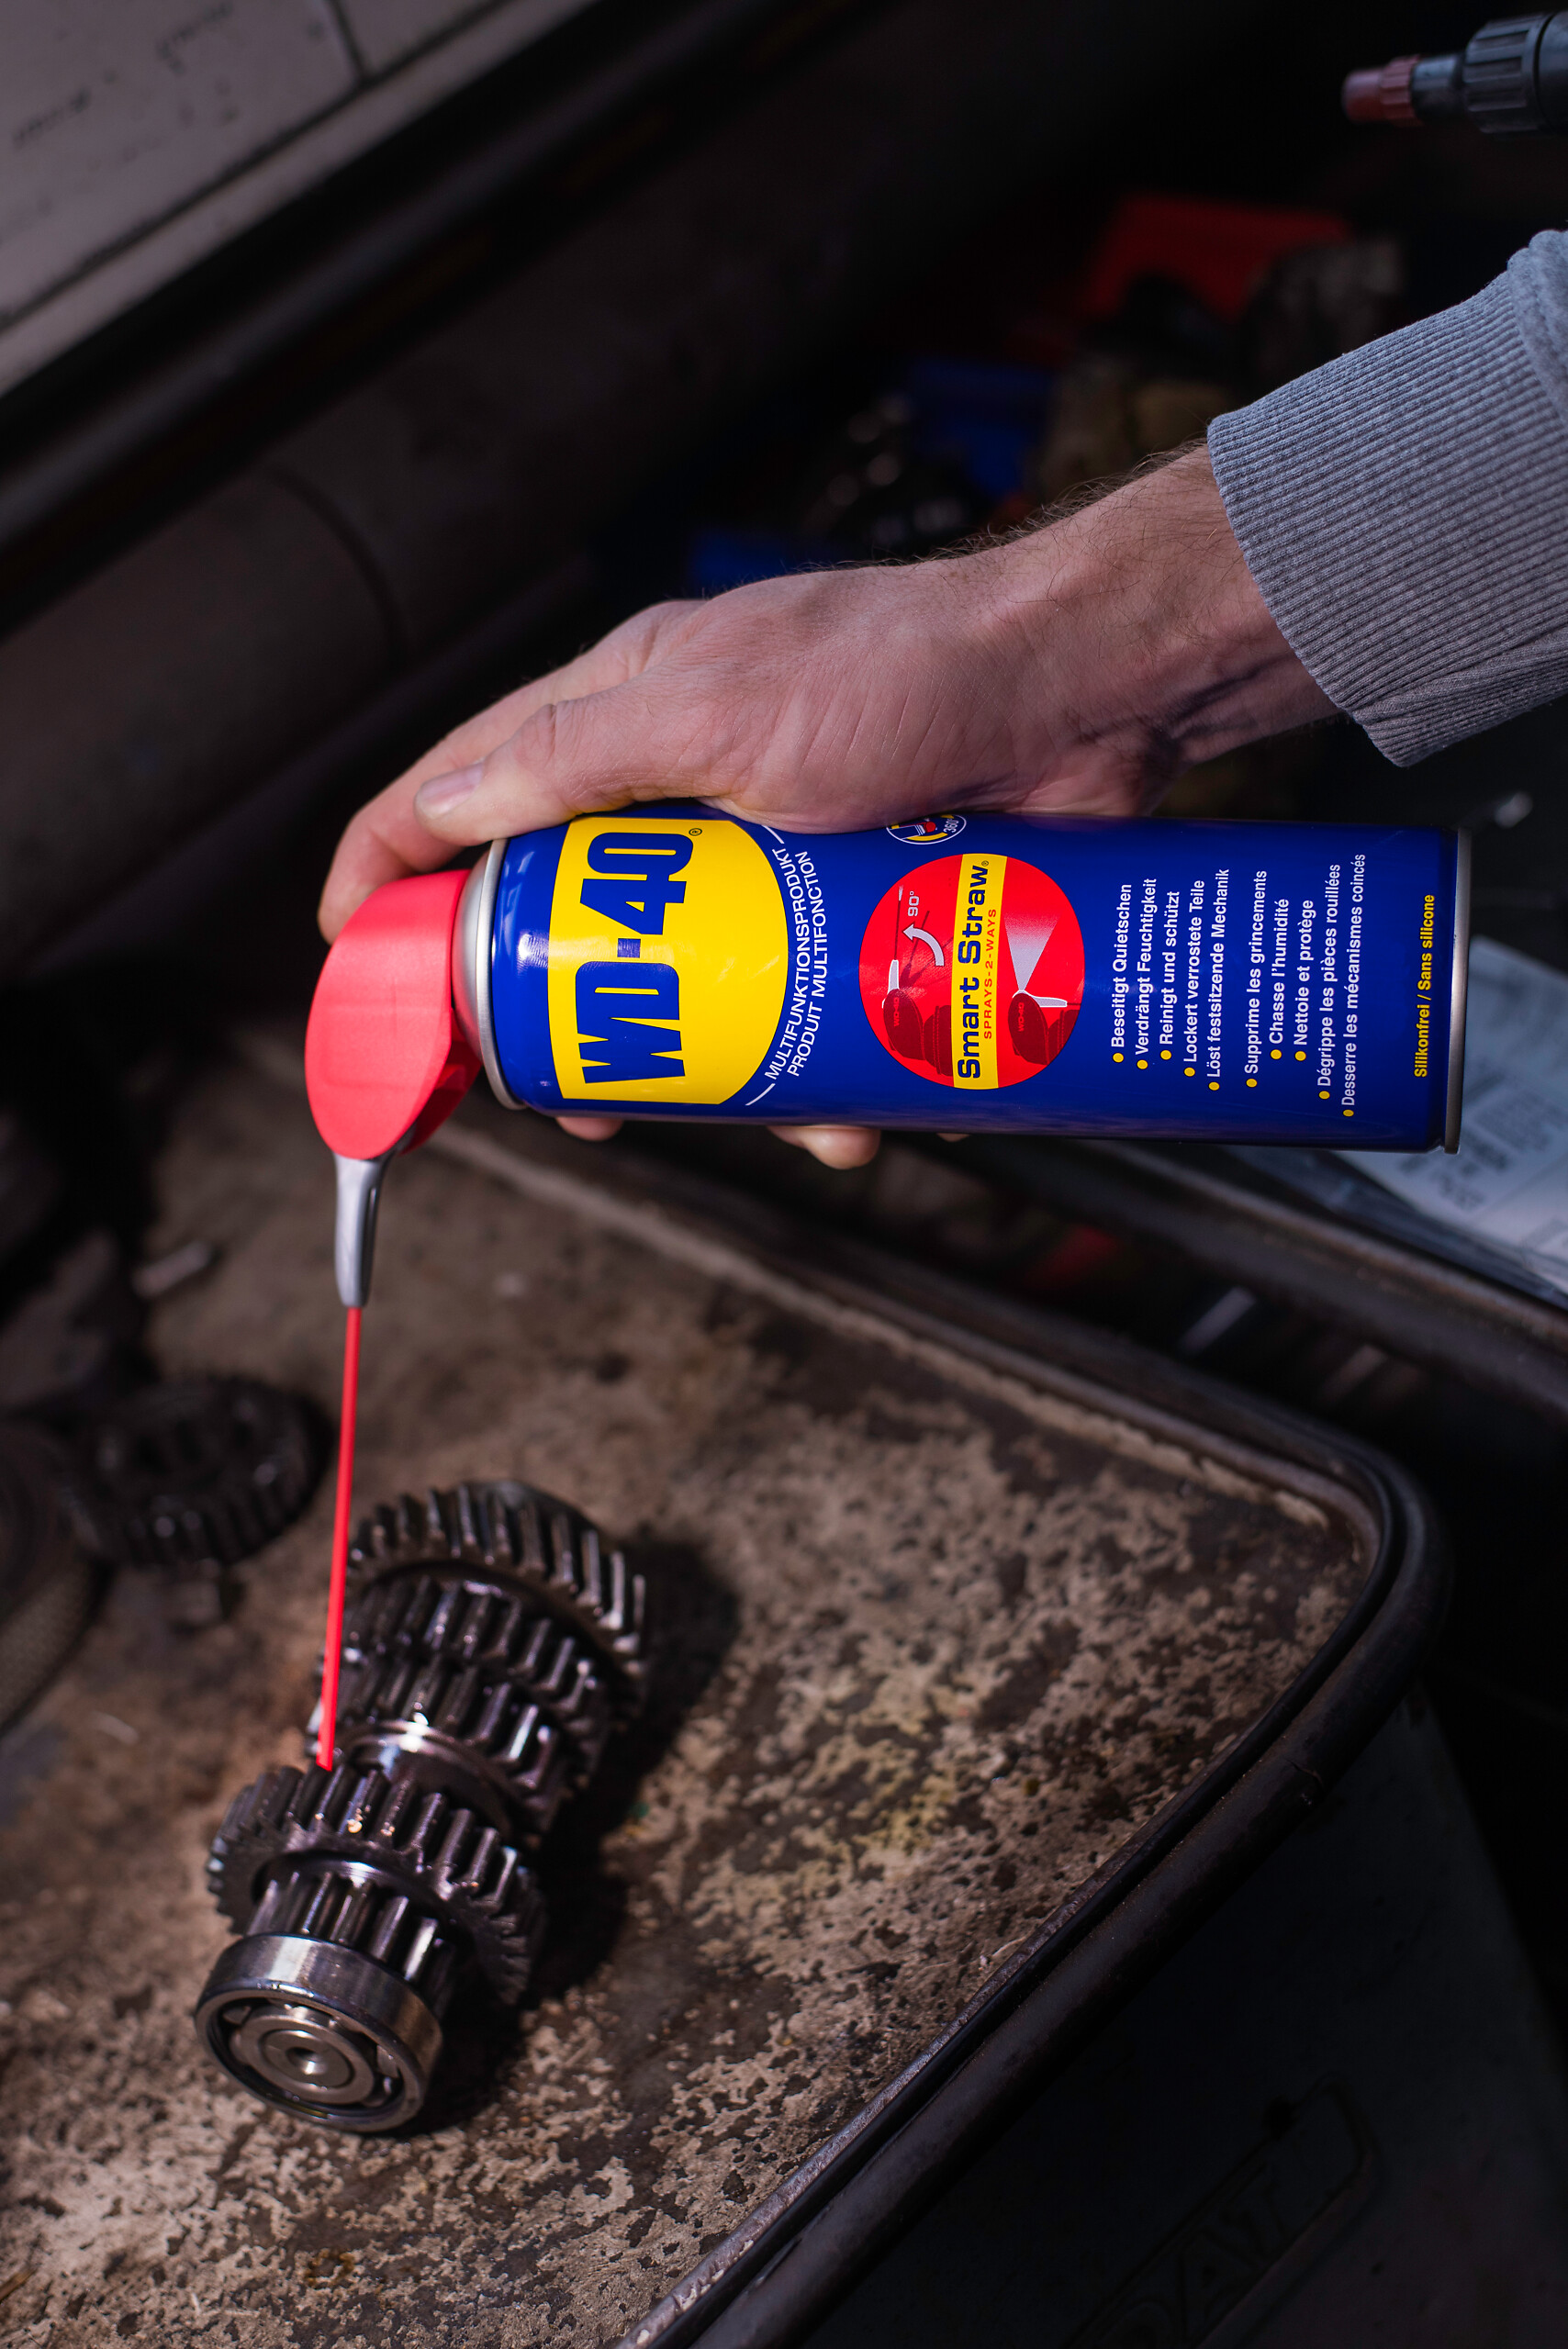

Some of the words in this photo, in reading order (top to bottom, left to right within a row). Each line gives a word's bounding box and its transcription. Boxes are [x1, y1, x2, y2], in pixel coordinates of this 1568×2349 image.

[1190, 879, 1204, 912] Teile
[1212, 869, 1229, 937] Mechanik
[1325, 864, 1340, 923] rouillées
[1350, 854, 1365, 902] coincés
[795, 851, 827, 997] MULTIFONCTION
[1113, 884, 1131, 972] Quietschen
[1137, 878, 1158, 972] Feuchtigkeit
[1164, 891, 1180, 946] schützt
[1249, 870, 1267, 963] grincements
[1297, 900, 1316, 961] protège
[1420, 894, 1435, 948] silicone
[765, 847, 810, 1079] MULTIFUNKTIONSPRODUKT
[983, 909, 996, 1039] SPRAYS-2-WAYS
[1163, 952, 1175, 982] und
[1188, 917, 1202, 999] verrostete
[1247, 968, 1260, 993] les
[1299, 966, 1309, 981] et
[1320, 928, 1338, 981] pièces
[1344, 906, 1362, 1009] mécanismes
[1418, 952, 1432, 990] Sans
[1111, 977, 1129, 1047] Beseitigt
[1136, 977, 1153, 1055] Verdrängt
[1159, 988, 1177, 1044] Reinigt
[1208, 943, 1224, 1042] festsitzende
[1270, 981, 1284, 1044] Chasse
[1294, 987, 1309, 1045] Nettoie
[1319, 987, 1334, 1012] les
[787, 1001, 822, 1076] PRODUIT
[958, 977, 980, 1078] Smart
[1184, 1004, 1198, 1062] Lockert
[1245, 998, 1261, 1074] Supprime
[1316, 1017, 1335, 1086] Dégrippe
[1343, 1013, 1358, 1037] les
[1415, 1005, 1430, 1077] Silikonfrei
[1207, 1046, 1221, 1077] Löst
[1341, 1043, 1356, 1105] Desserre
